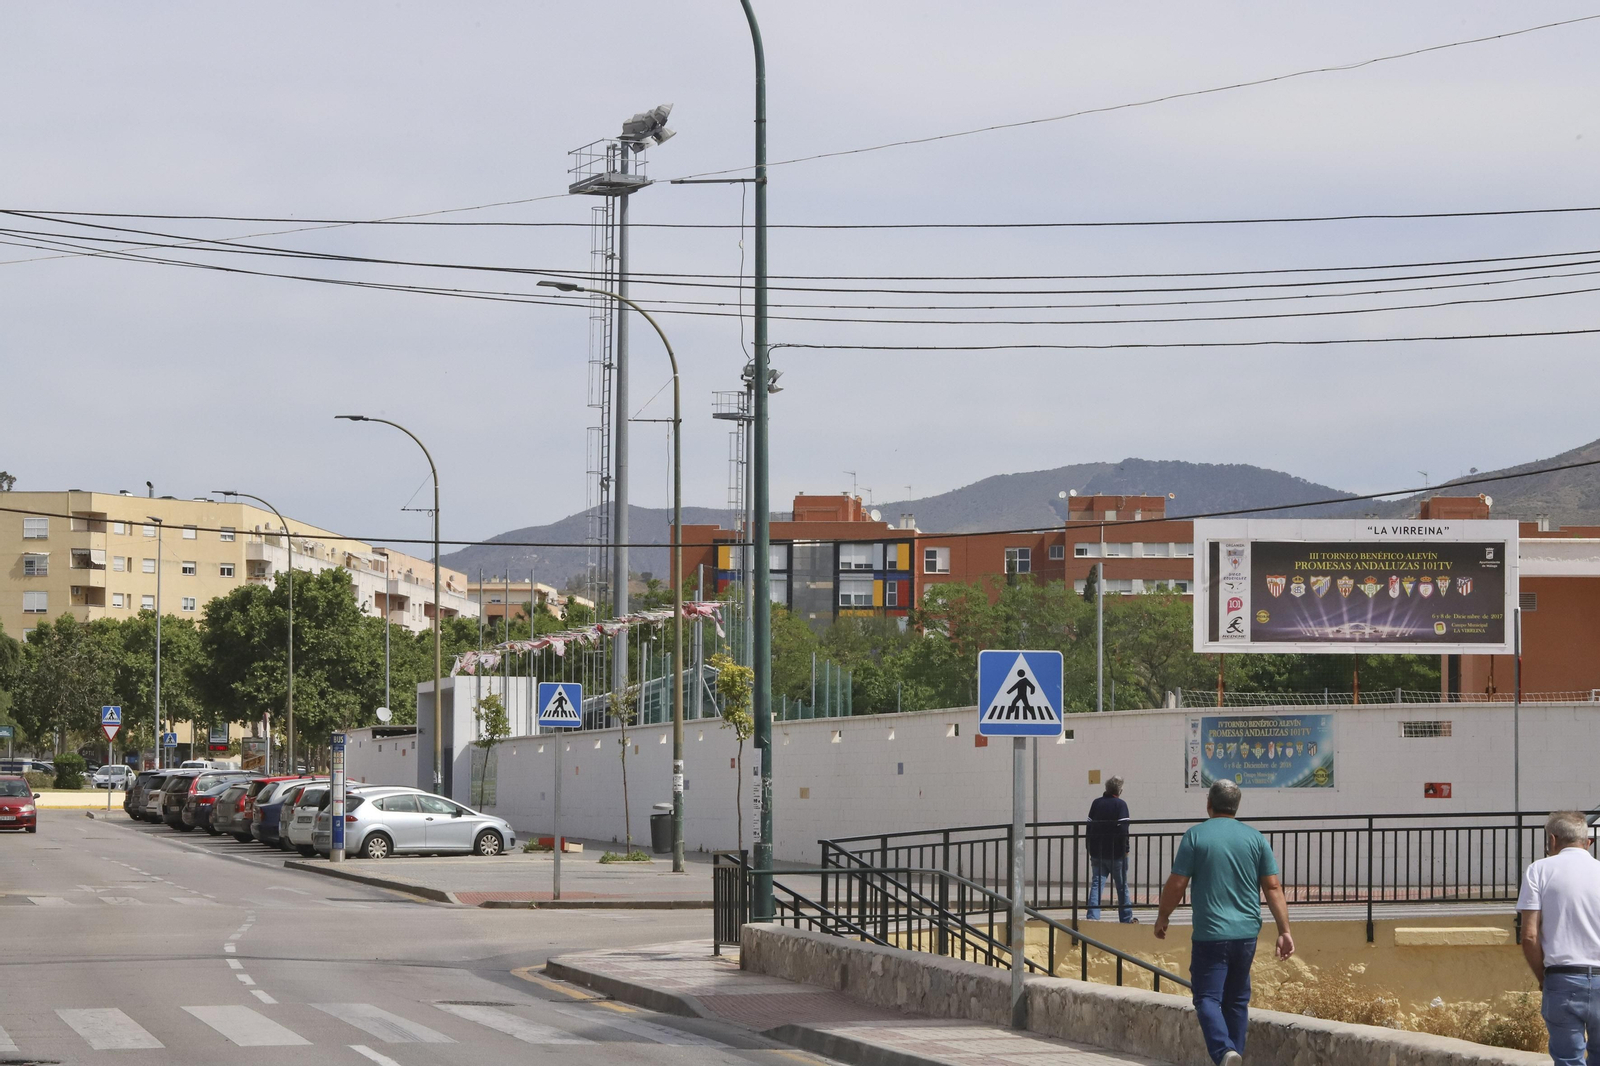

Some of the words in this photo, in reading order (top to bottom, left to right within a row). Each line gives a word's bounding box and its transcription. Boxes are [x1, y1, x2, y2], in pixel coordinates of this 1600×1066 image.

[1360, 551, 1403, 560] BENÉFICO
[1406, 551, 1438, 560] ALEVÍN
[1295, 562, 1352, 570] PROMESAS
[1354, 562, 1419, 570] ANDALUZAS
[1423, 562, 1452, 570] 101TV
[1229, 600, 1241, 608] 101
[1245, 728, 1288, 736] ANDALUZAS
[333, 735, 344, 744] BUS
